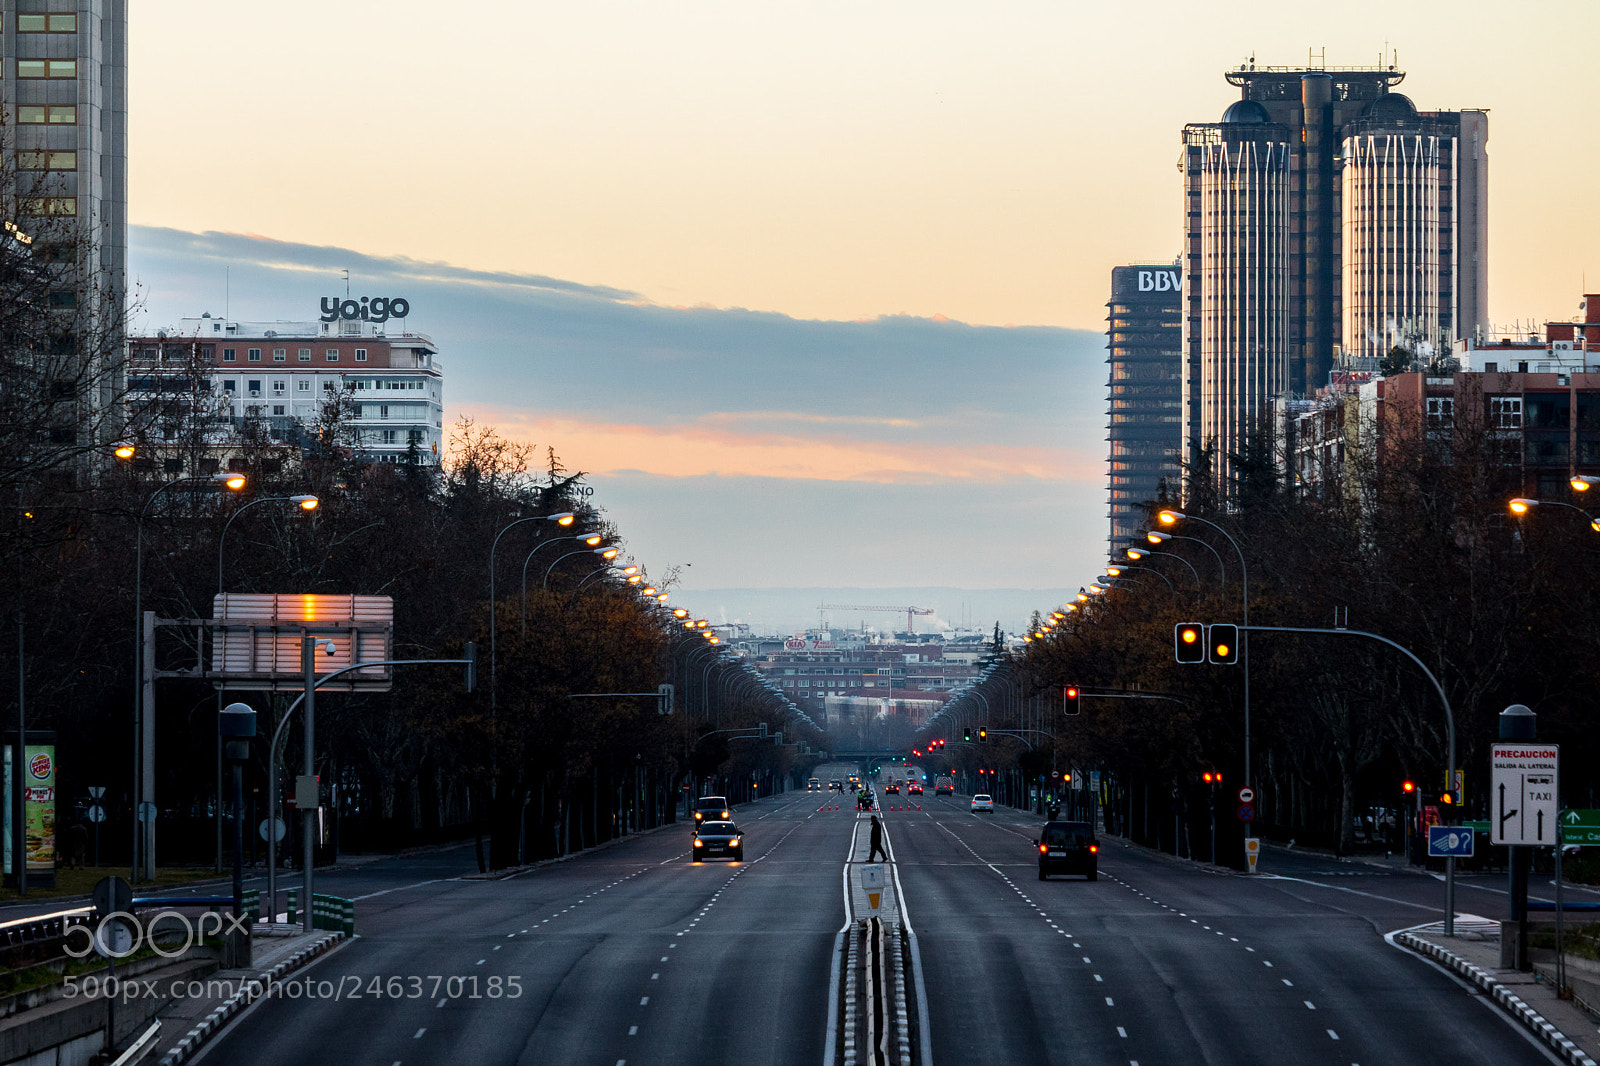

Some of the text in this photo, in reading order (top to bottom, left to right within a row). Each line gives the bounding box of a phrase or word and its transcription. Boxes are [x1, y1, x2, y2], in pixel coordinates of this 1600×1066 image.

[320, 296, 410, 323] yoigo
[1494, 750, 1556, 759] PRECAUCIÓN
[32, 757, 50, 768] BURGER
[32, 763, 51, 774] KING
[25, 787, 32, 801] 2
[1529, 792, 1552, 801] TAXI
